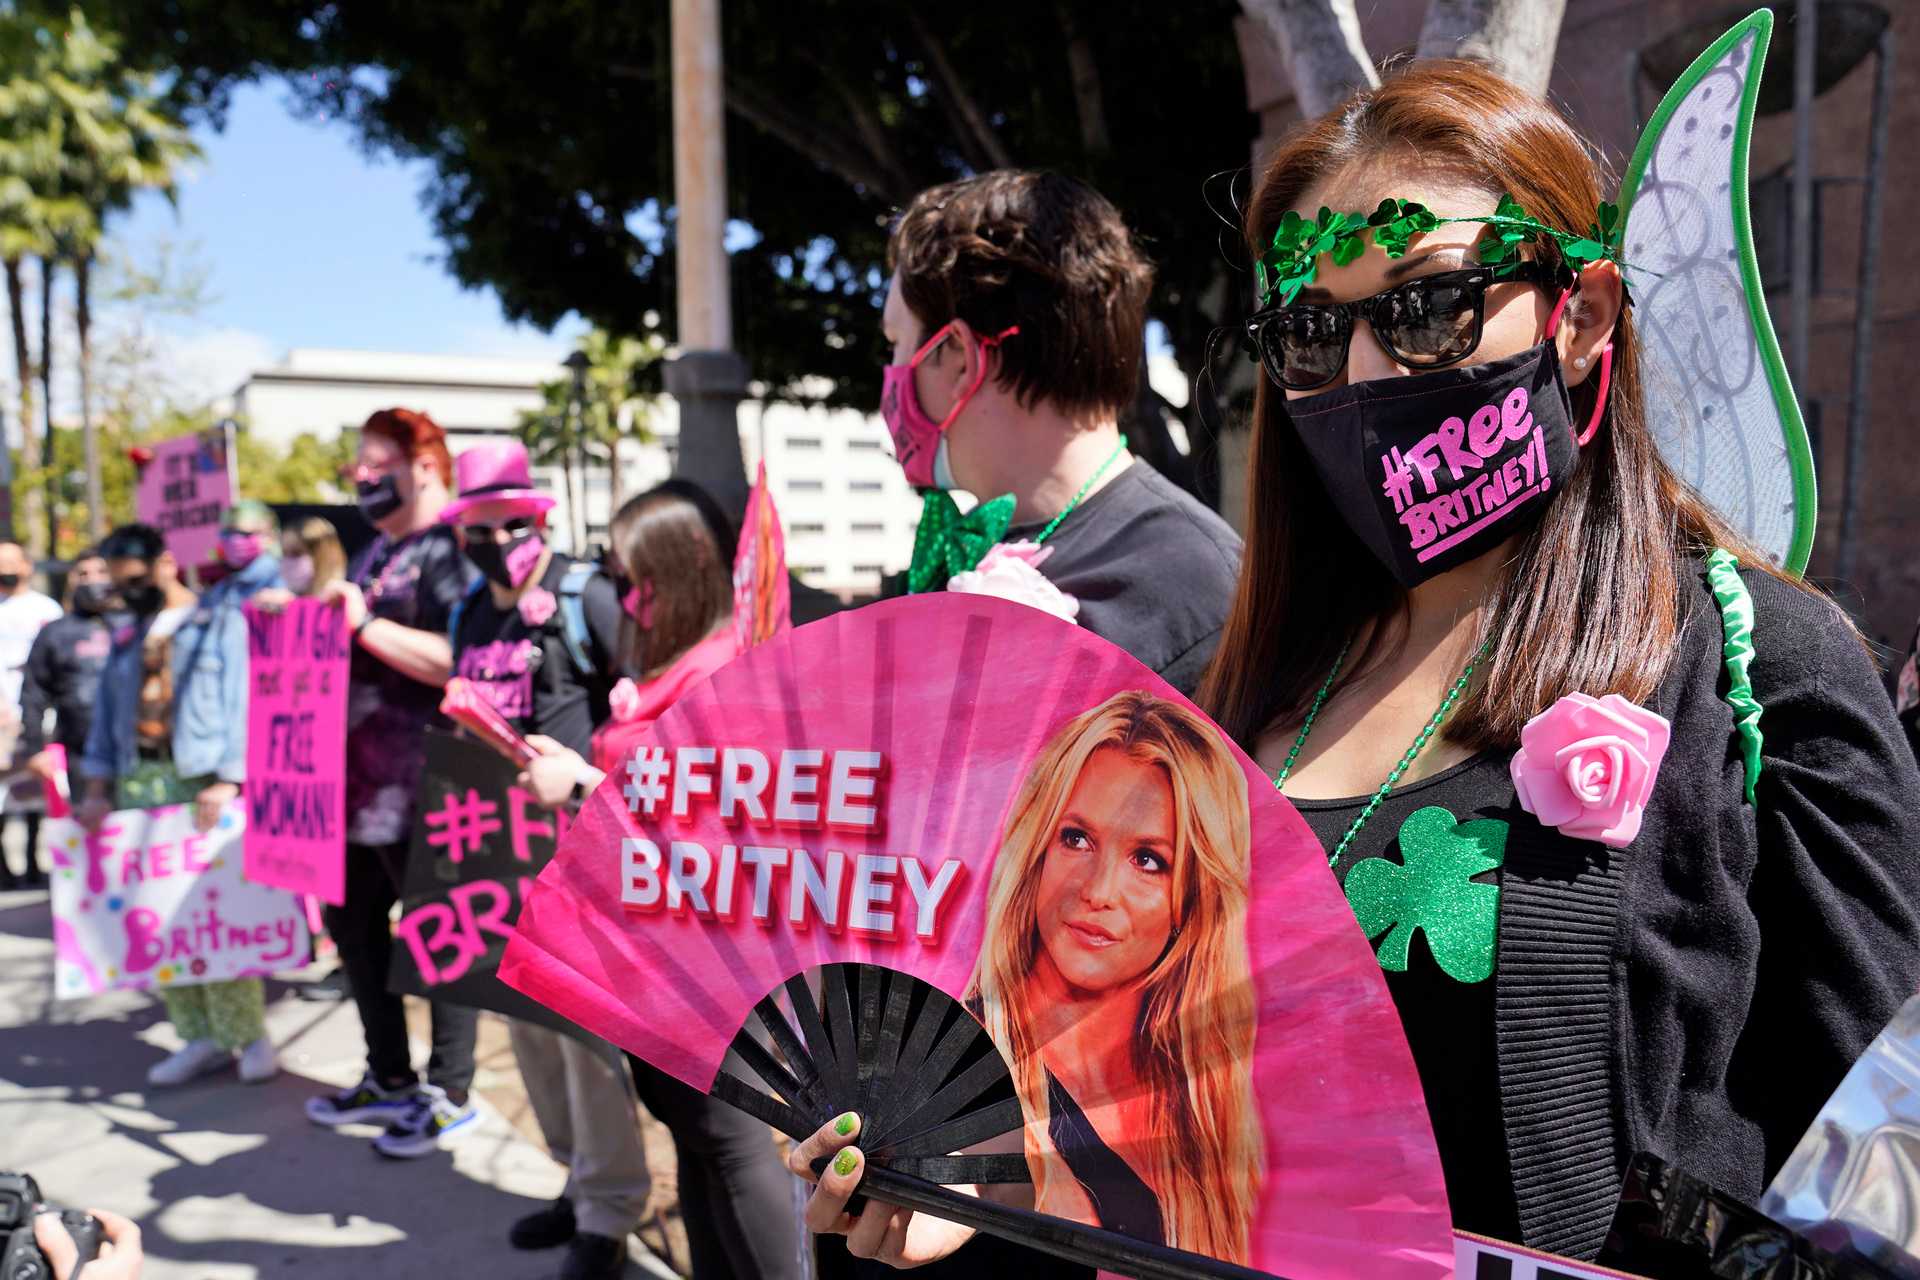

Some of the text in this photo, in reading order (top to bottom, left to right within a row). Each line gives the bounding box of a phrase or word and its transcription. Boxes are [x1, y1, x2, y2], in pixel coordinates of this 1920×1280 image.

[1398, 424, 1552, 549] BRITNEY!
[267, 711, 315, 774] FREE
[248, 780, 336, 840] WOMAN!
[621, 746, 888, 833] #FREE
[620, 837, 966, 941] BRITNEY
